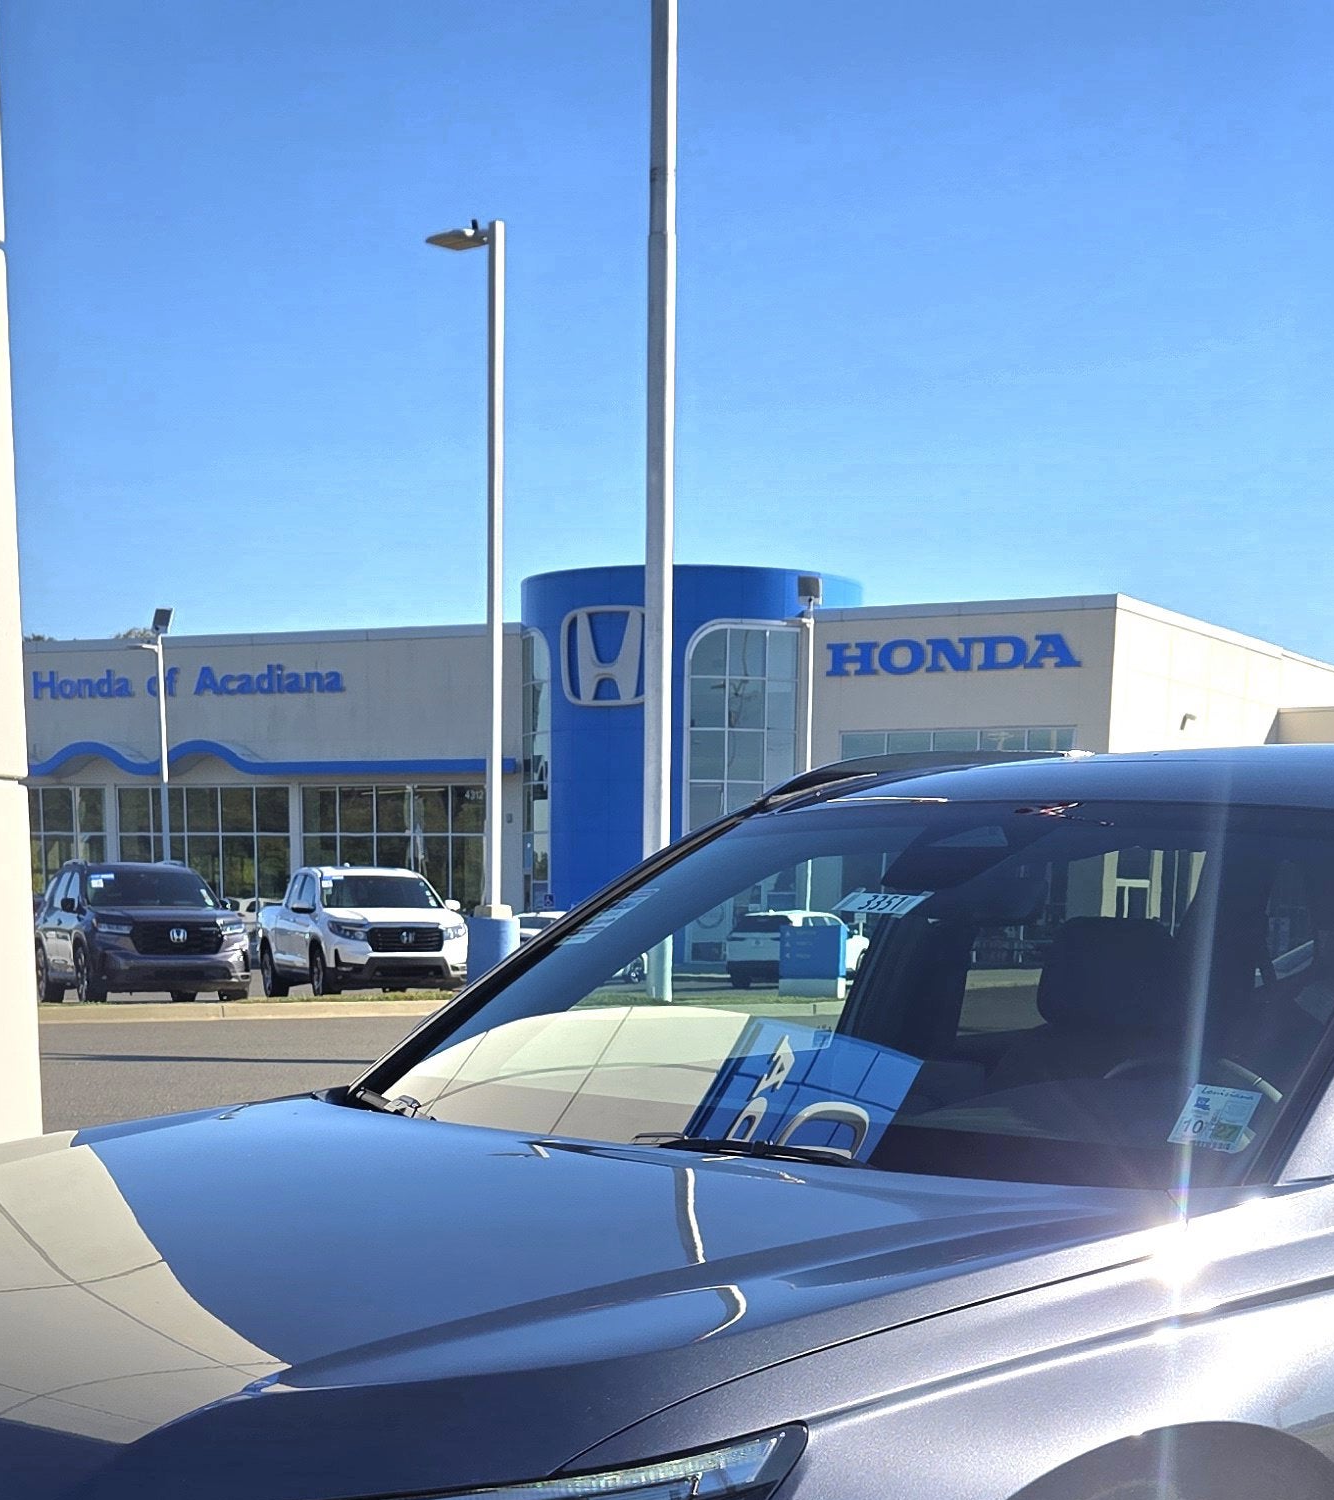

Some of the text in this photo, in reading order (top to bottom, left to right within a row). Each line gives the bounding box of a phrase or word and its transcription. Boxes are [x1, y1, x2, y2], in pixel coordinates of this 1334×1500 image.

[826, 633, 1081, 677] HONDA
[32, 669, 134, 700] Honda
[193, 664, 344, 696] Acadiana
[857, 894, 909, 912] 3351
